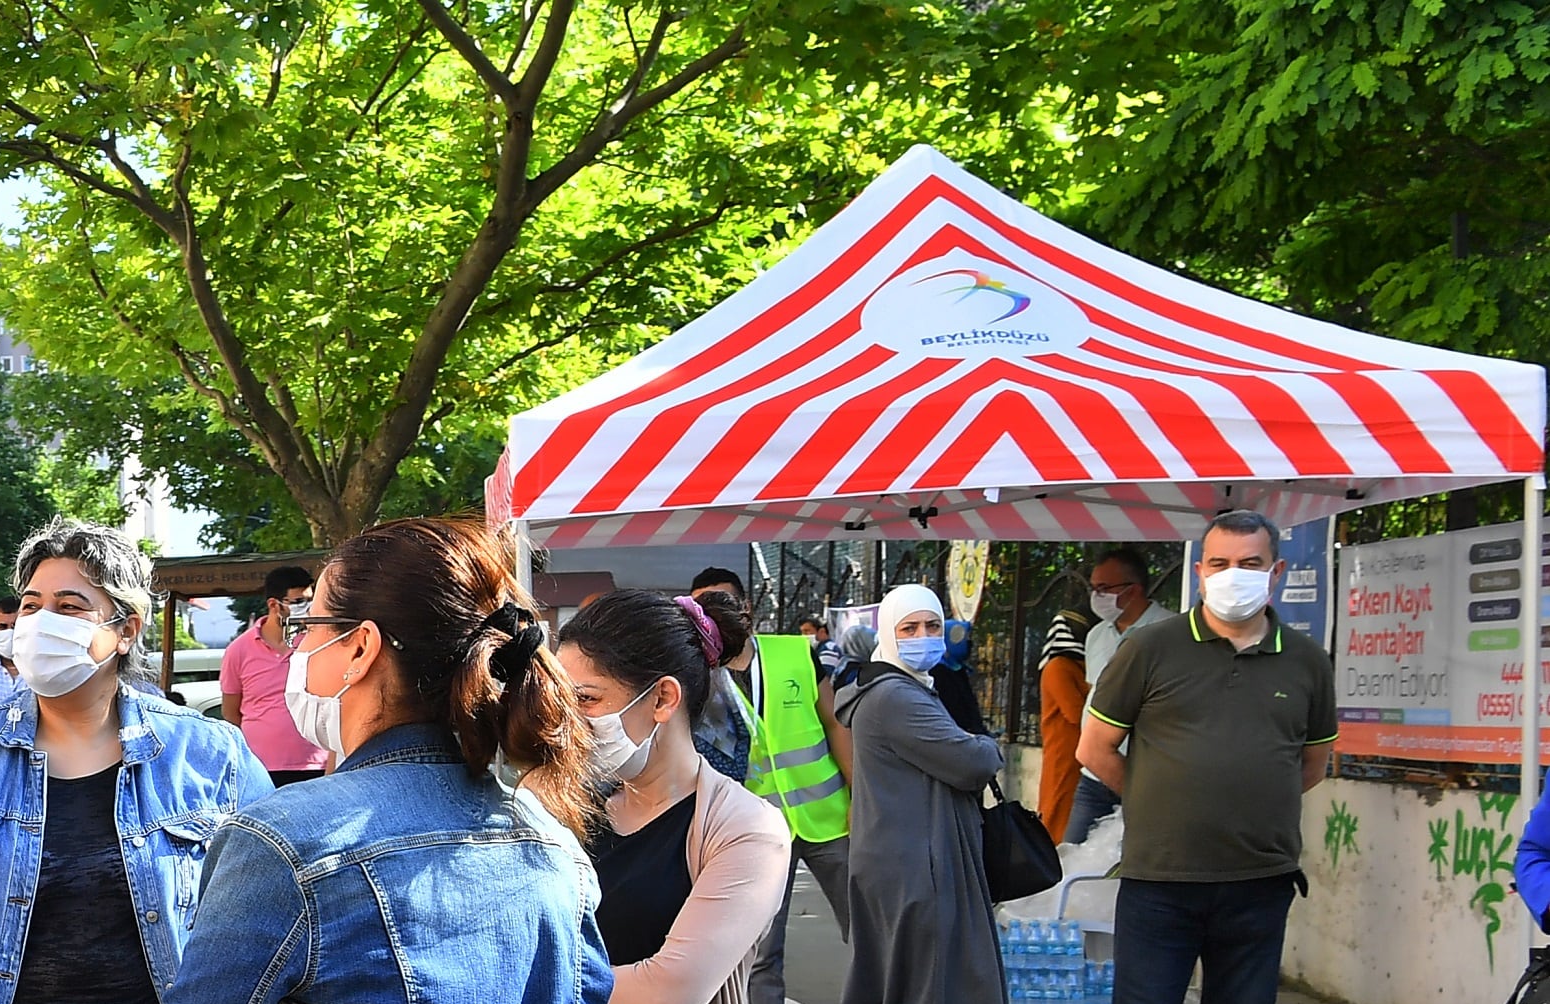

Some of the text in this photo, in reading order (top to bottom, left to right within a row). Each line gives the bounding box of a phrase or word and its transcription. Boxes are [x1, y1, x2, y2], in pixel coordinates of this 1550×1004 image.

[921, 329, 1050, 346] BEYLİKDÜZÜ
[947, 338, 1029, 348] BELEDİYESİ
[1348, 583, 1432, 620] Erken Kayıt
[1347, 667, 1394, 697] Devam
[1477, 693, 1515, 721] (0555)
